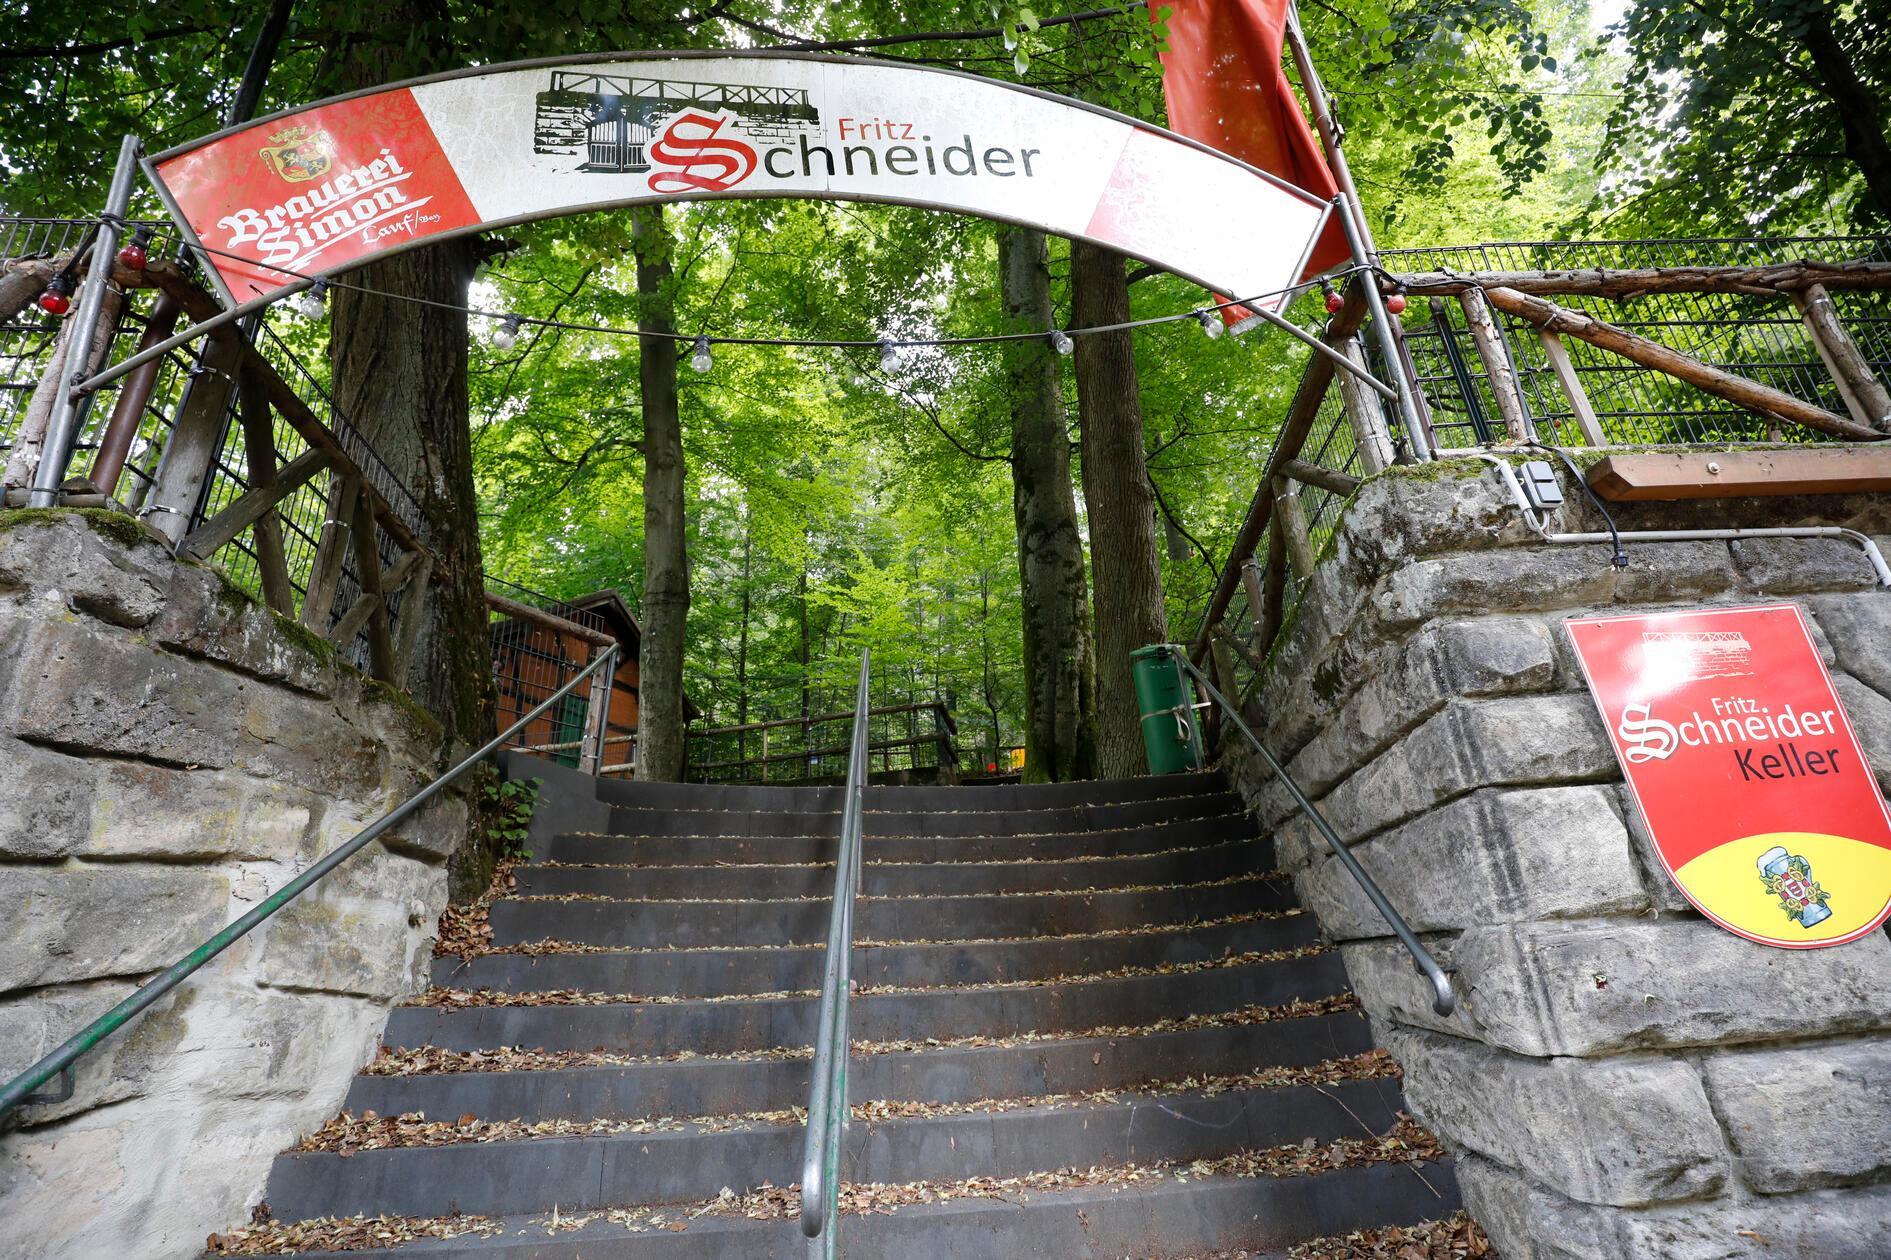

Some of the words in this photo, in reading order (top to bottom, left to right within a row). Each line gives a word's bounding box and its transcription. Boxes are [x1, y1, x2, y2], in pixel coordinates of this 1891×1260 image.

[648, 113, 1040, 193] Schneider
[839, 117, 916, 141] Fritz
[217, 148, 404, 248] Brauerei
[256, 185, 407, 270] Simon
[1618, 702, 1835, 763] Schneider
[1711, 696, 1760, 716] Fritz
[1734, 743, 1840, 782] Keller
